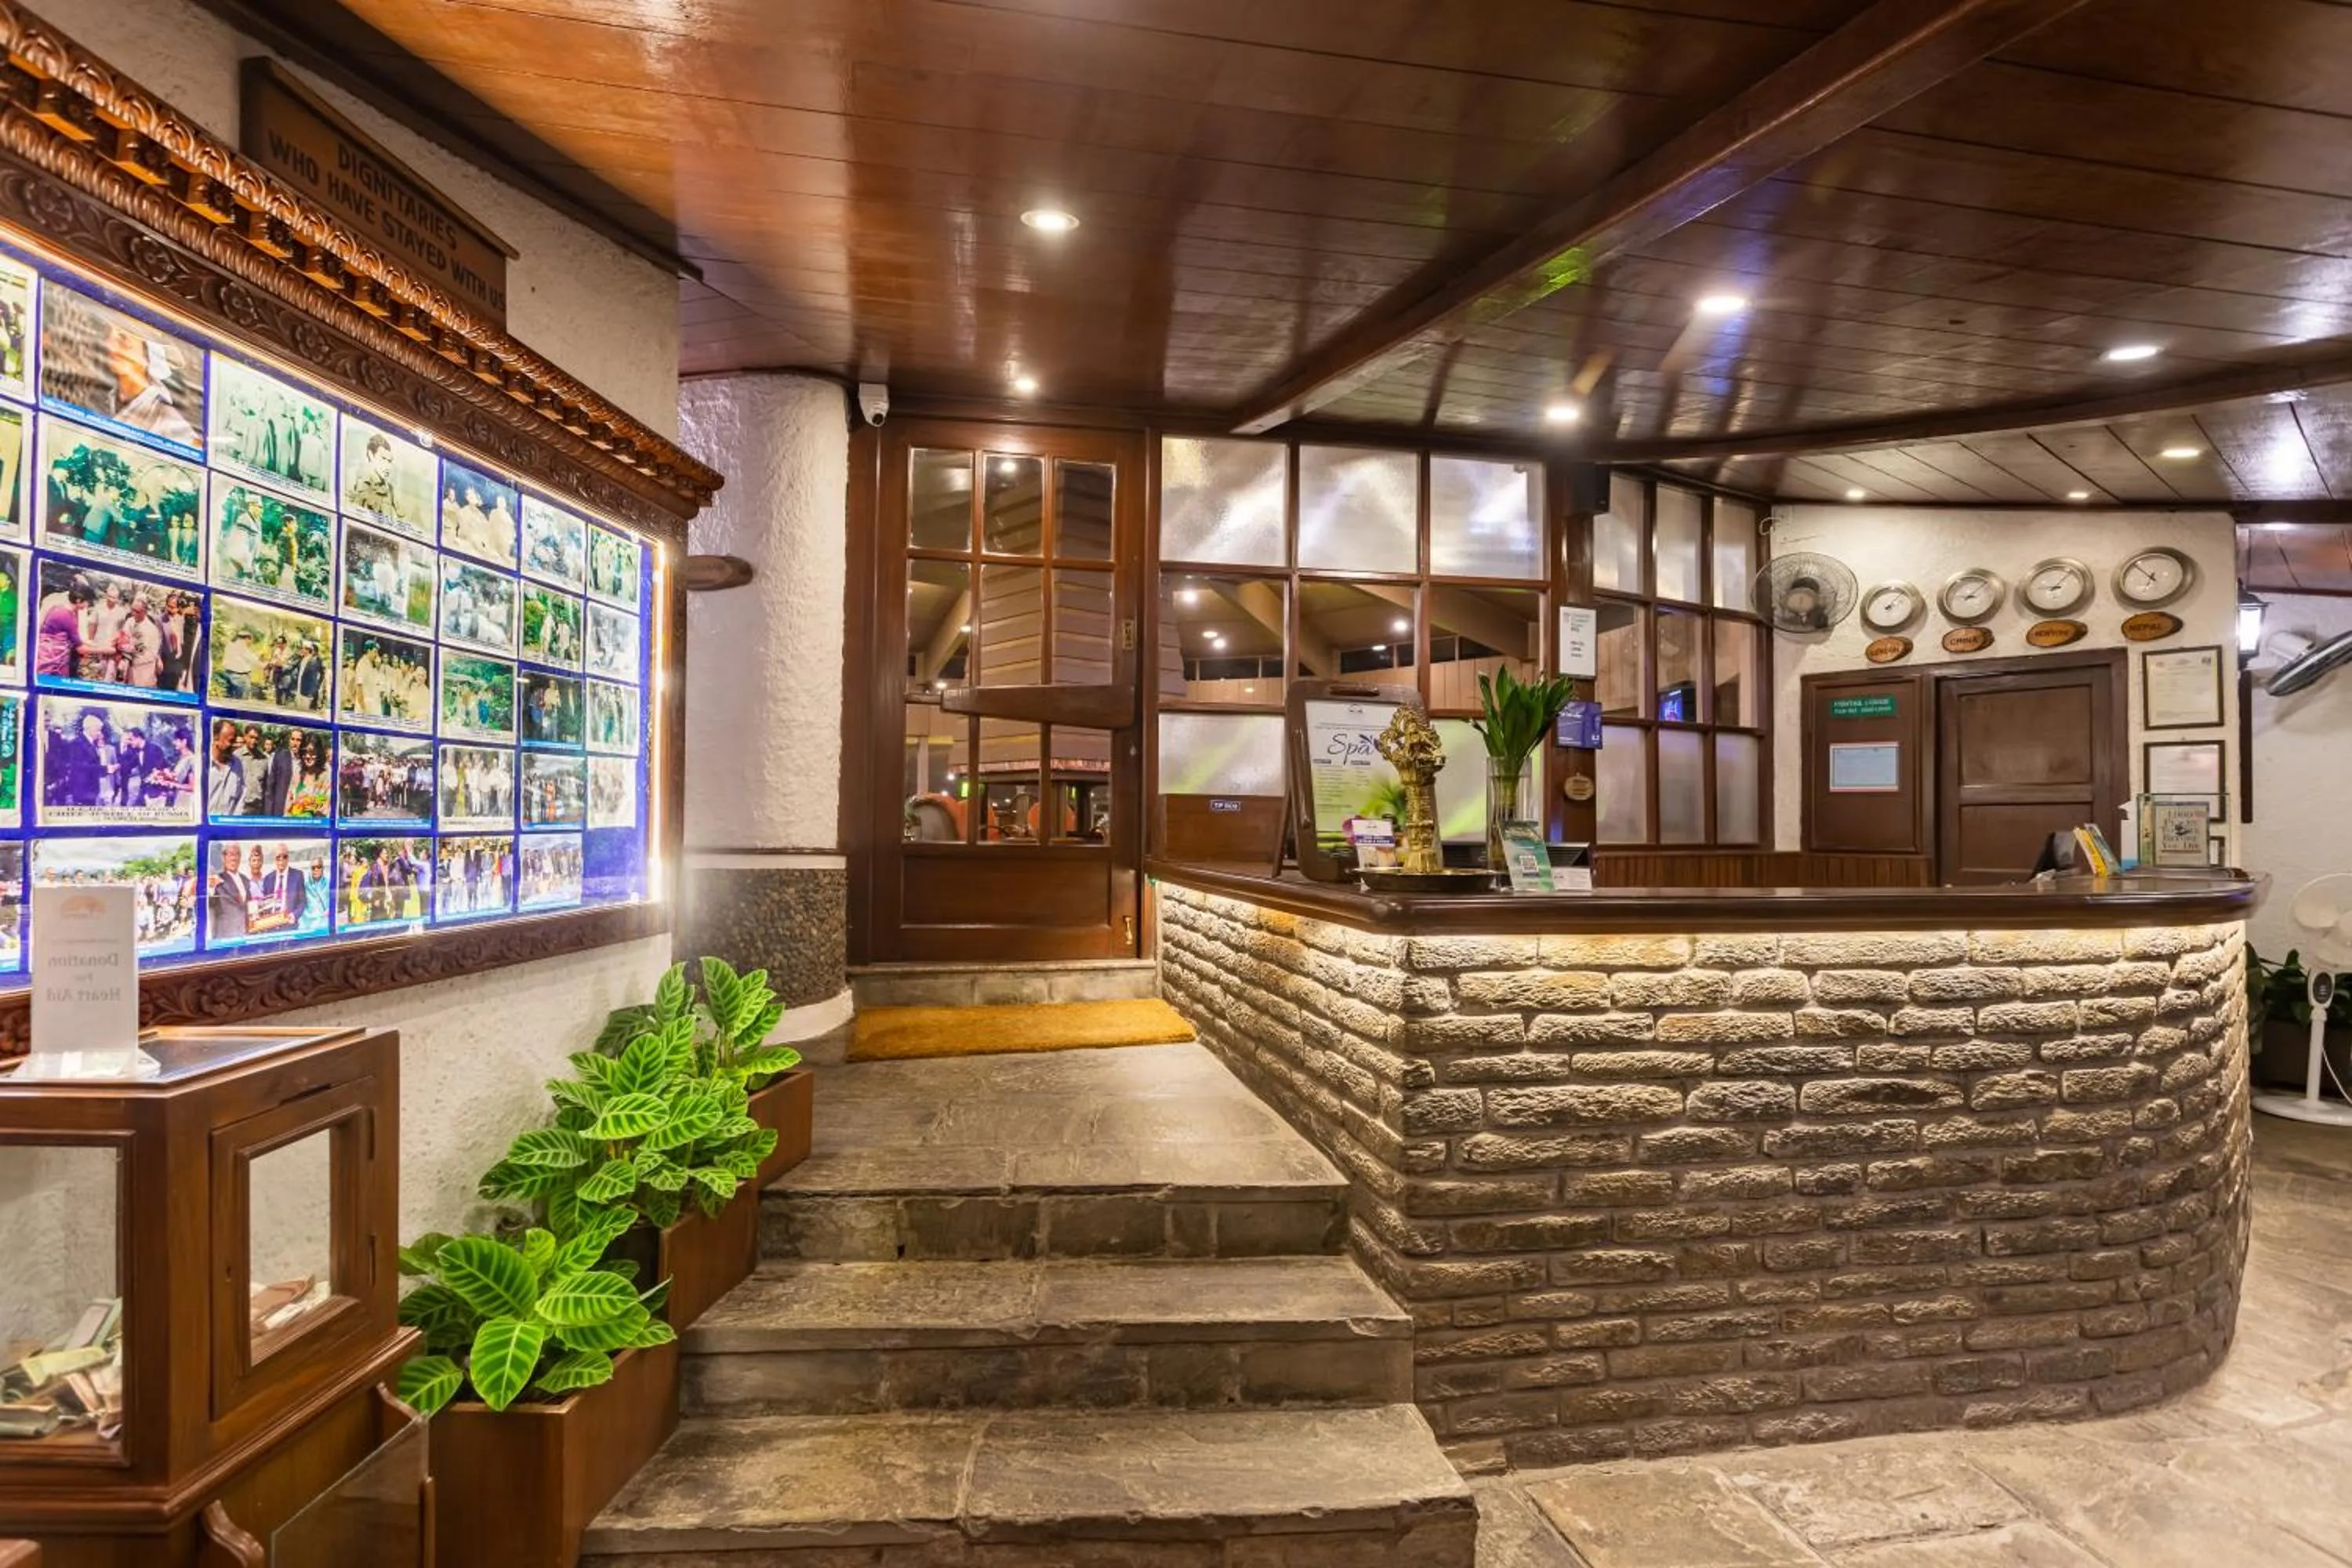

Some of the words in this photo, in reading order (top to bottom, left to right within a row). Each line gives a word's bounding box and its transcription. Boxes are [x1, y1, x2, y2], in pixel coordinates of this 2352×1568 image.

[268, 131, 320, 186] WHO
[327, 172, 376, 225] HAVE
[382, 209, 447, 271] STAYED
[450, 258, 486, 300] WITH
[488, 288, 506, 310] US
[338, 143, 458, 250] DIGNITARIES
[1949, 637, 1979, 646] CHINA
[1327, 733, 1374, 766] Spa
